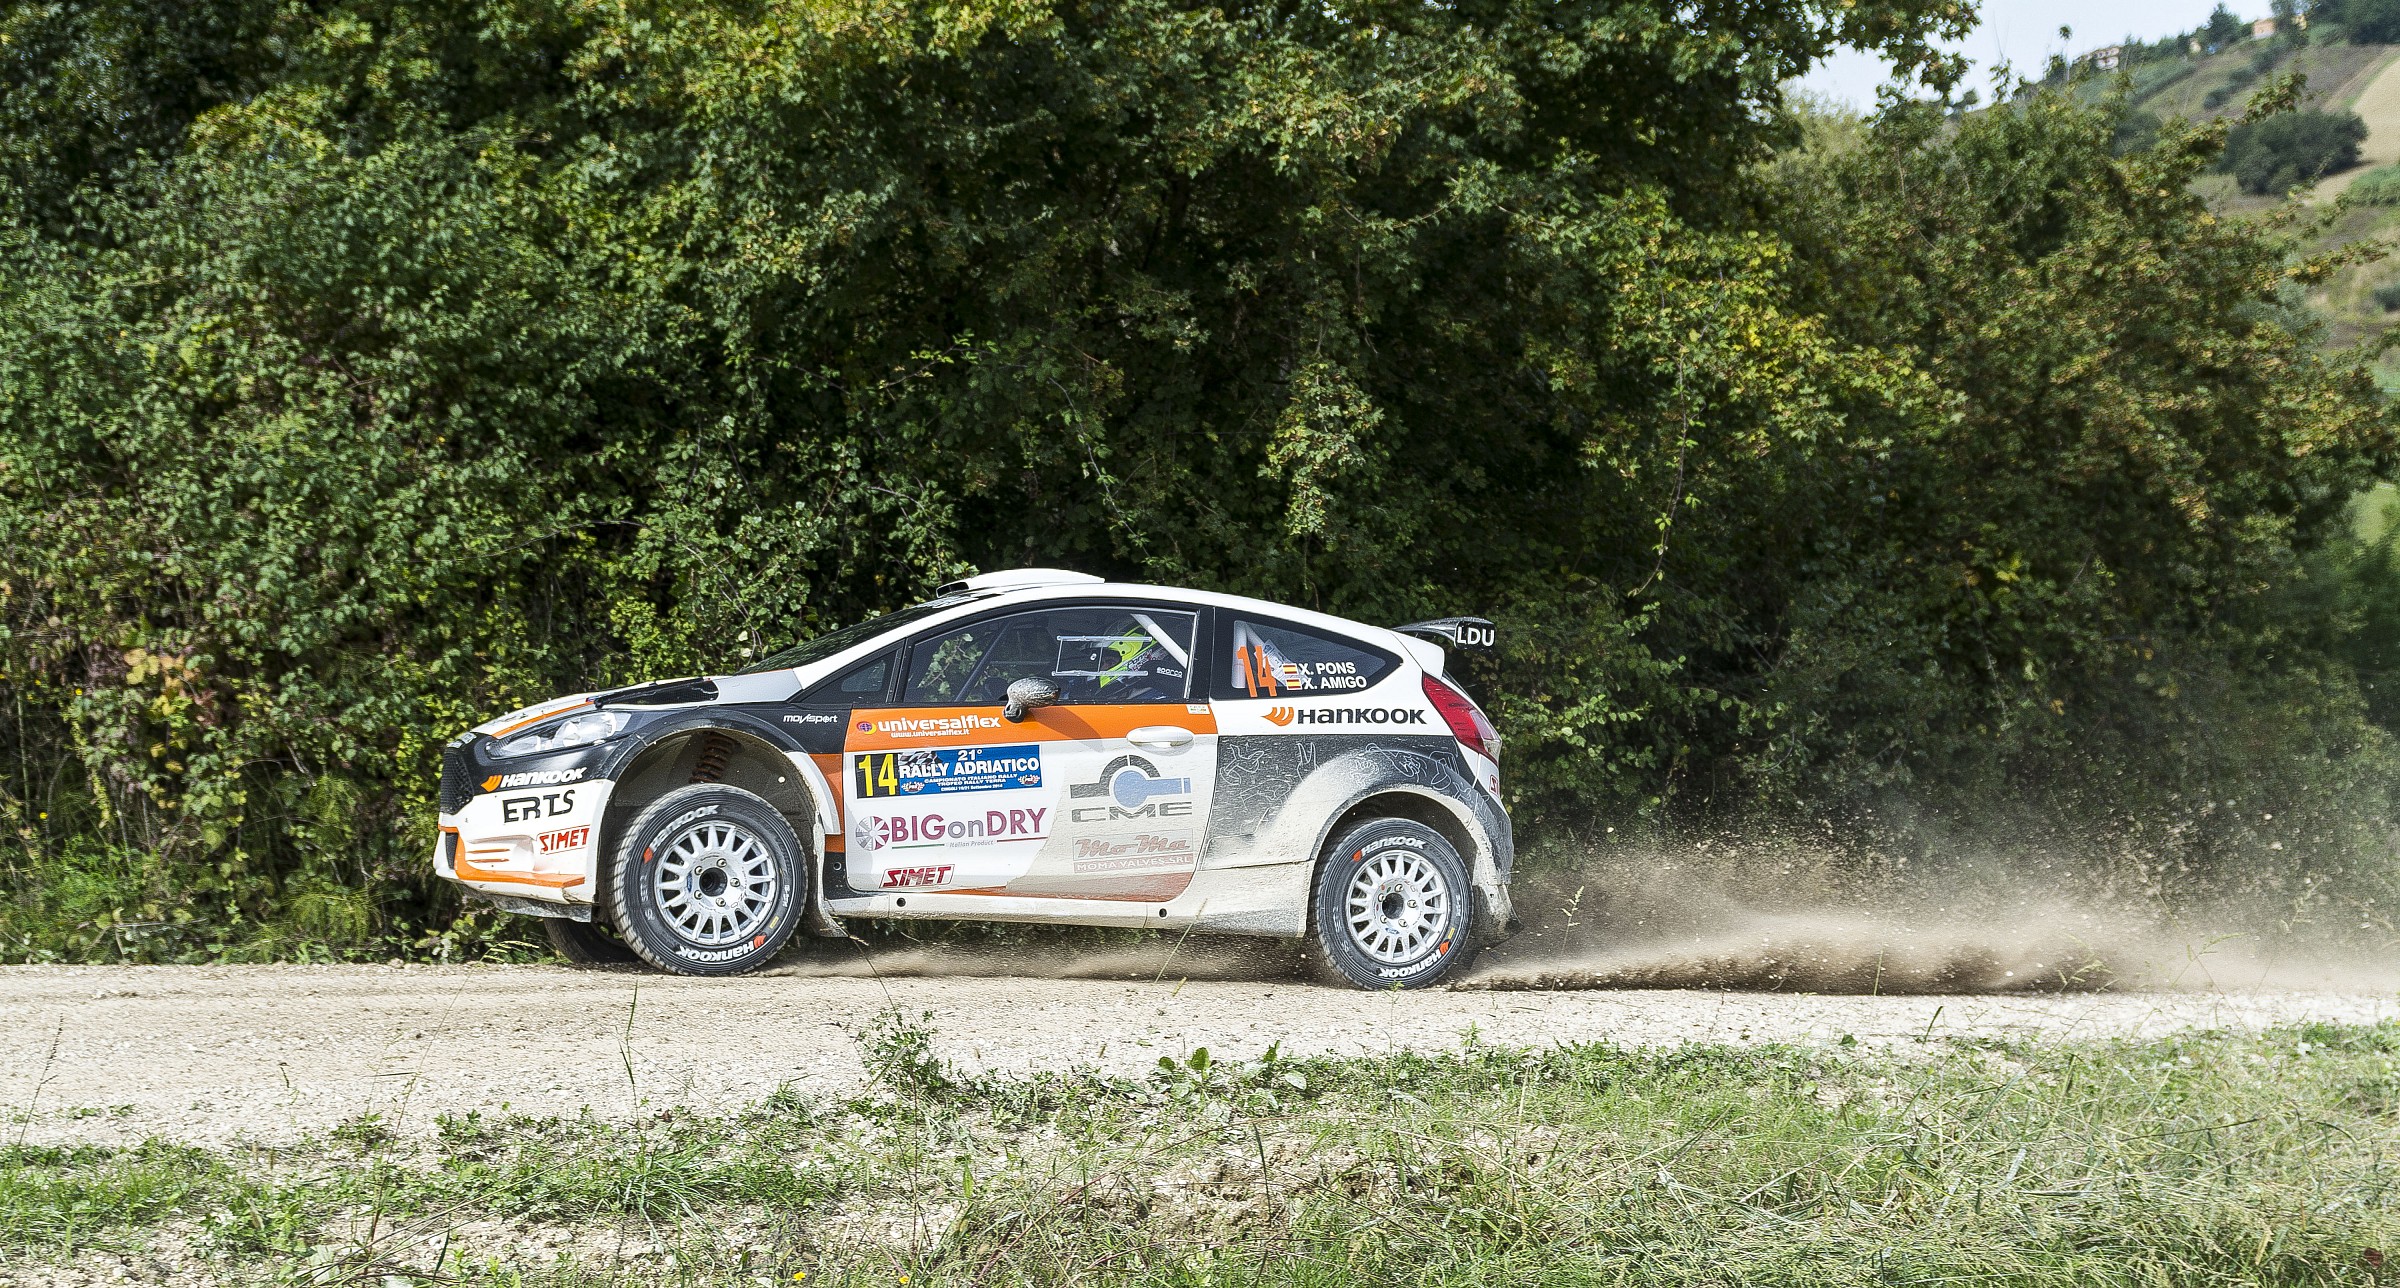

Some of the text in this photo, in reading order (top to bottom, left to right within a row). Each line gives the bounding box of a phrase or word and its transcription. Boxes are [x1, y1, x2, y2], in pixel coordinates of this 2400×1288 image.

[1457, 626, 1496, 647] LDU
[1236, 645, 1277, 698] 14
[1317, 662, 1357, 675] PONS
[1320, 676, 1367, 689] AMIGO
[877, 714, 1001, 732] universalflex
[858, 754, 898, 797] 14
[899, 757, 1040, 779] RALLY ADRIATICO
[503, 789, 575, 823] ERTS
[1071, 801, 1193, 823] CME
[539, 828, 590, 852] SIMET
[1077, 855, 1190, 871] MOMA VALVES SRL
[883, 866, 952, 887] SIMET
